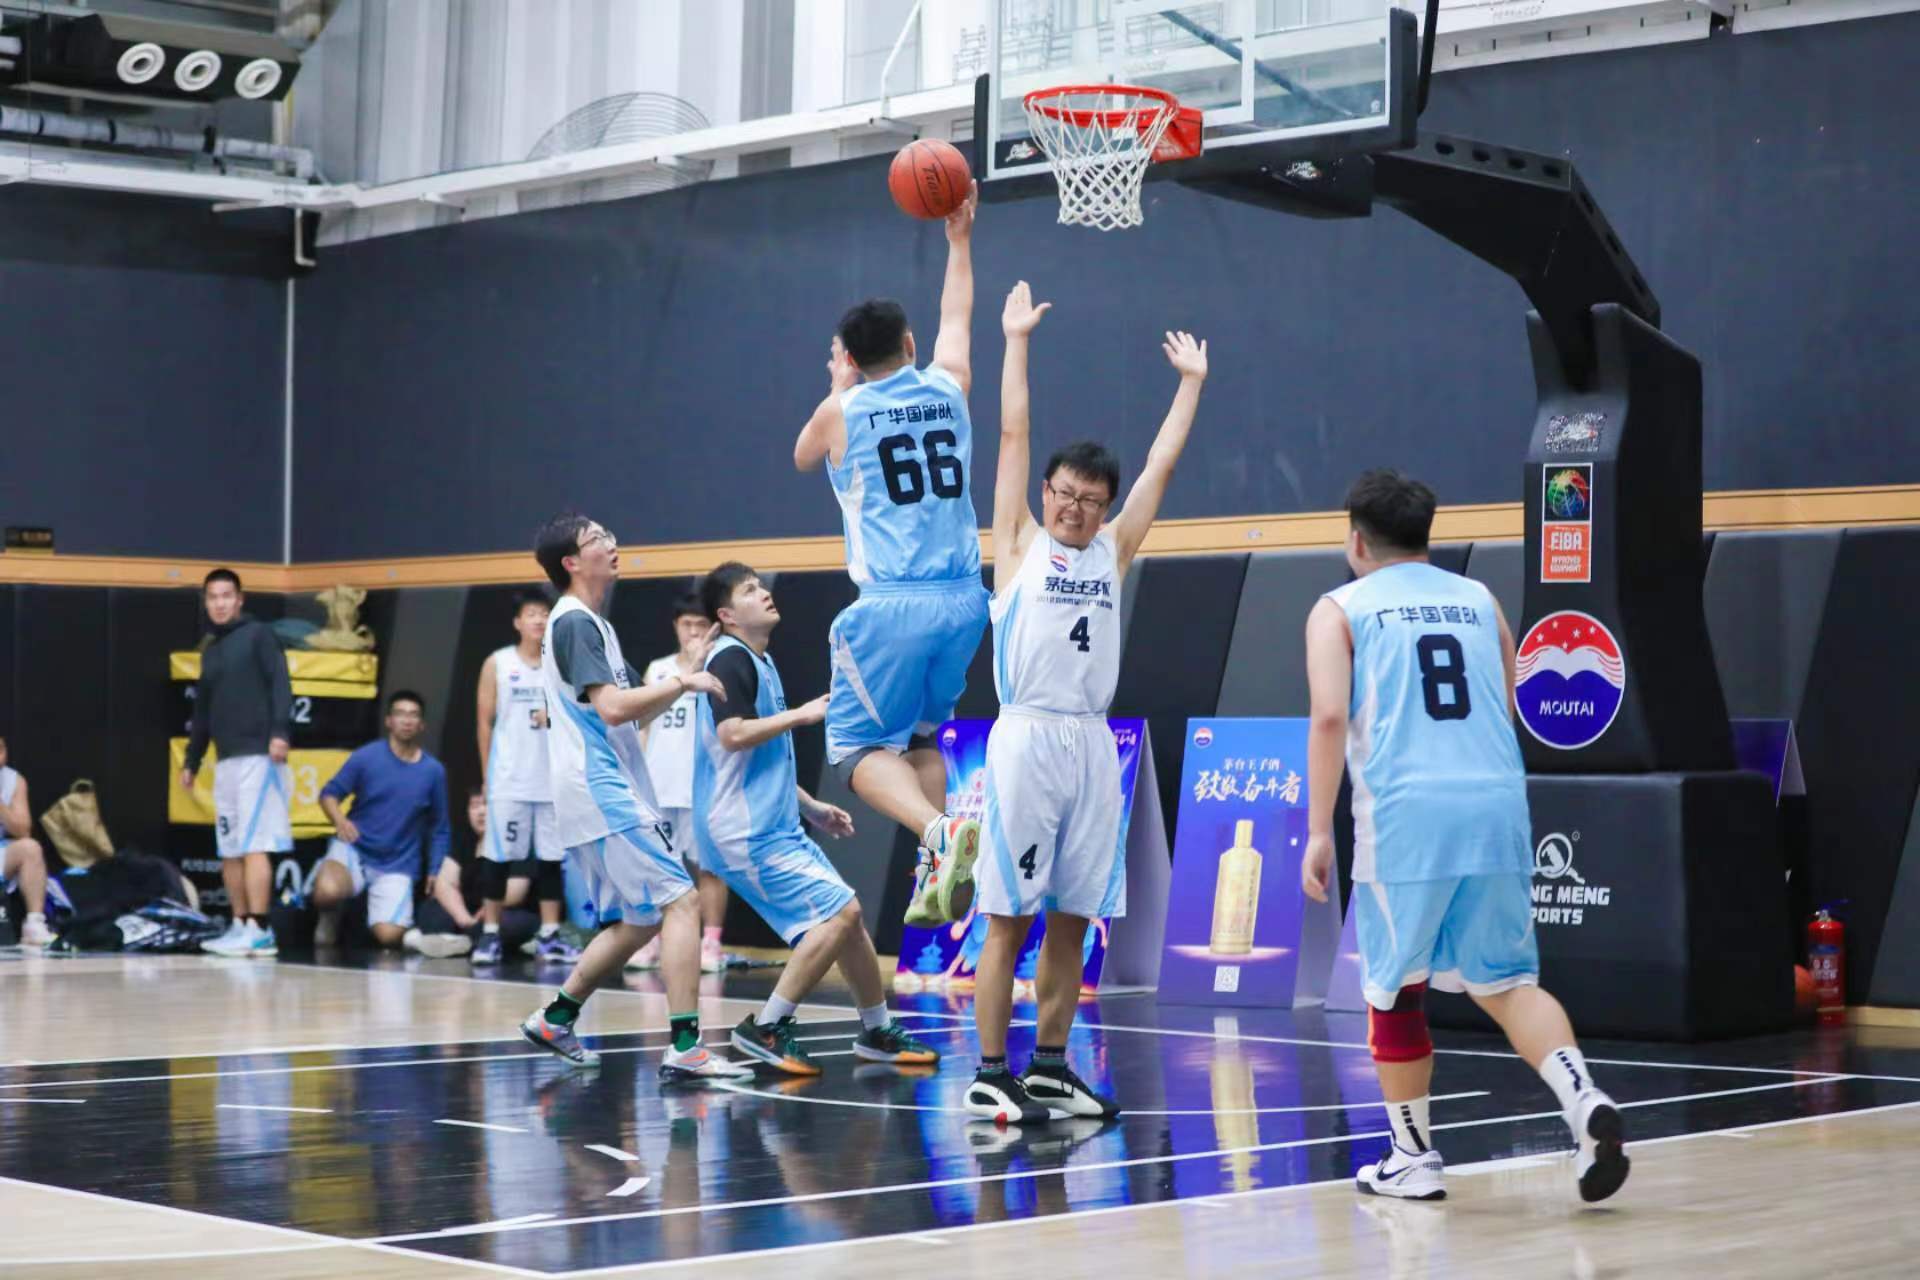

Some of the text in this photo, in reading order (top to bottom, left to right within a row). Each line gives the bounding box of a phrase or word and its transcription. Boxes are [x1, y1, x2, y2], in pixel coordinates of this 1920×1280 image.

[868, 401, 953, 429] 广华国管队
[877, 429, 963, 505] 66
[1376, 605, 1481, 629] 广华国管队
[1069, 615, 1090, 652] 4
[1416, 633, 1472, 721] 8
[291, 697, 311, 723] 2
[1539, 700, 1594, 716] MOUTAI
[1194, 770, 1302, 804] 致敬奋斗者
[506, 821, 519, 842] 5
[1018, 843, 1038, 880] 4
[1530, 885, 1611, 906] NG MENG
[1530, 907, 1584, 925] PORTS
